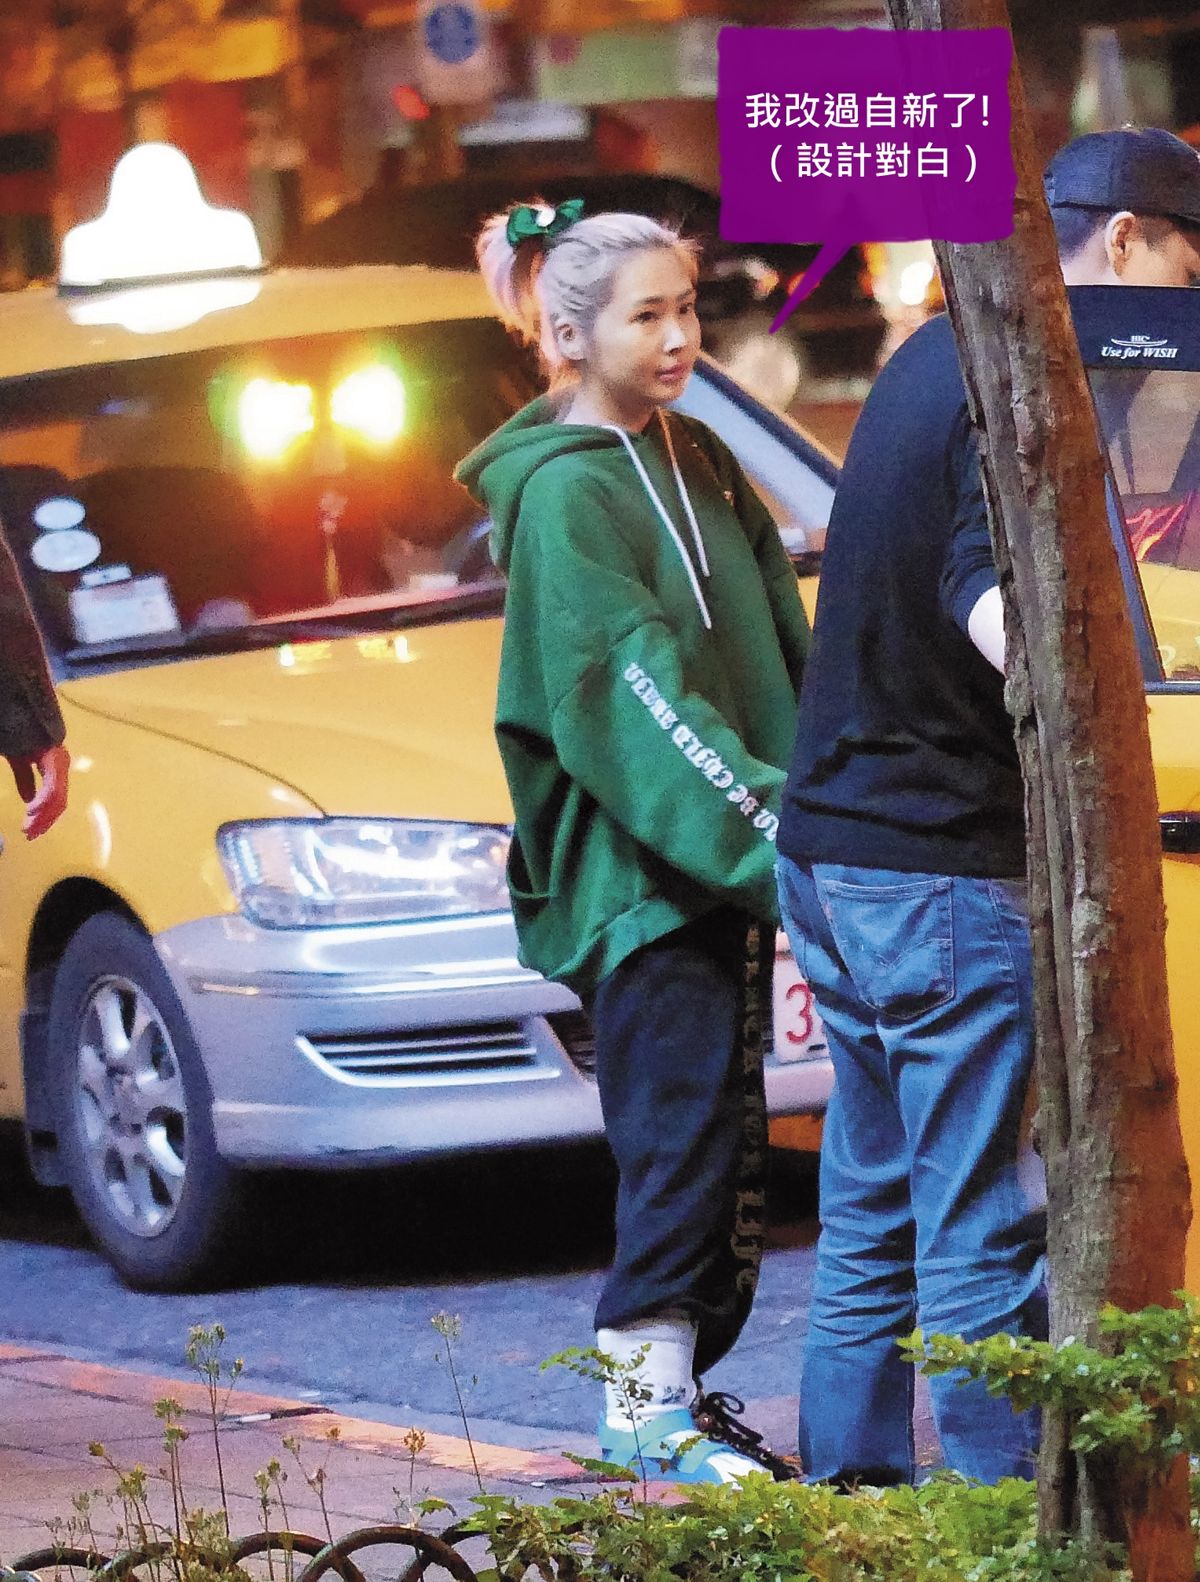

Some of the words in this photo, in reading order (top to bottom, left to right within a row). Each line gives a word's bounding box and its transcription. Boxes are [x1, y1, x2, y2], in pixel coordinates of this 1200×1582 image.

[1101, 346, 1121, 357] Use
[1120, 347, 1141, 359] for
[1142, 347, 1178, 358] WISH
